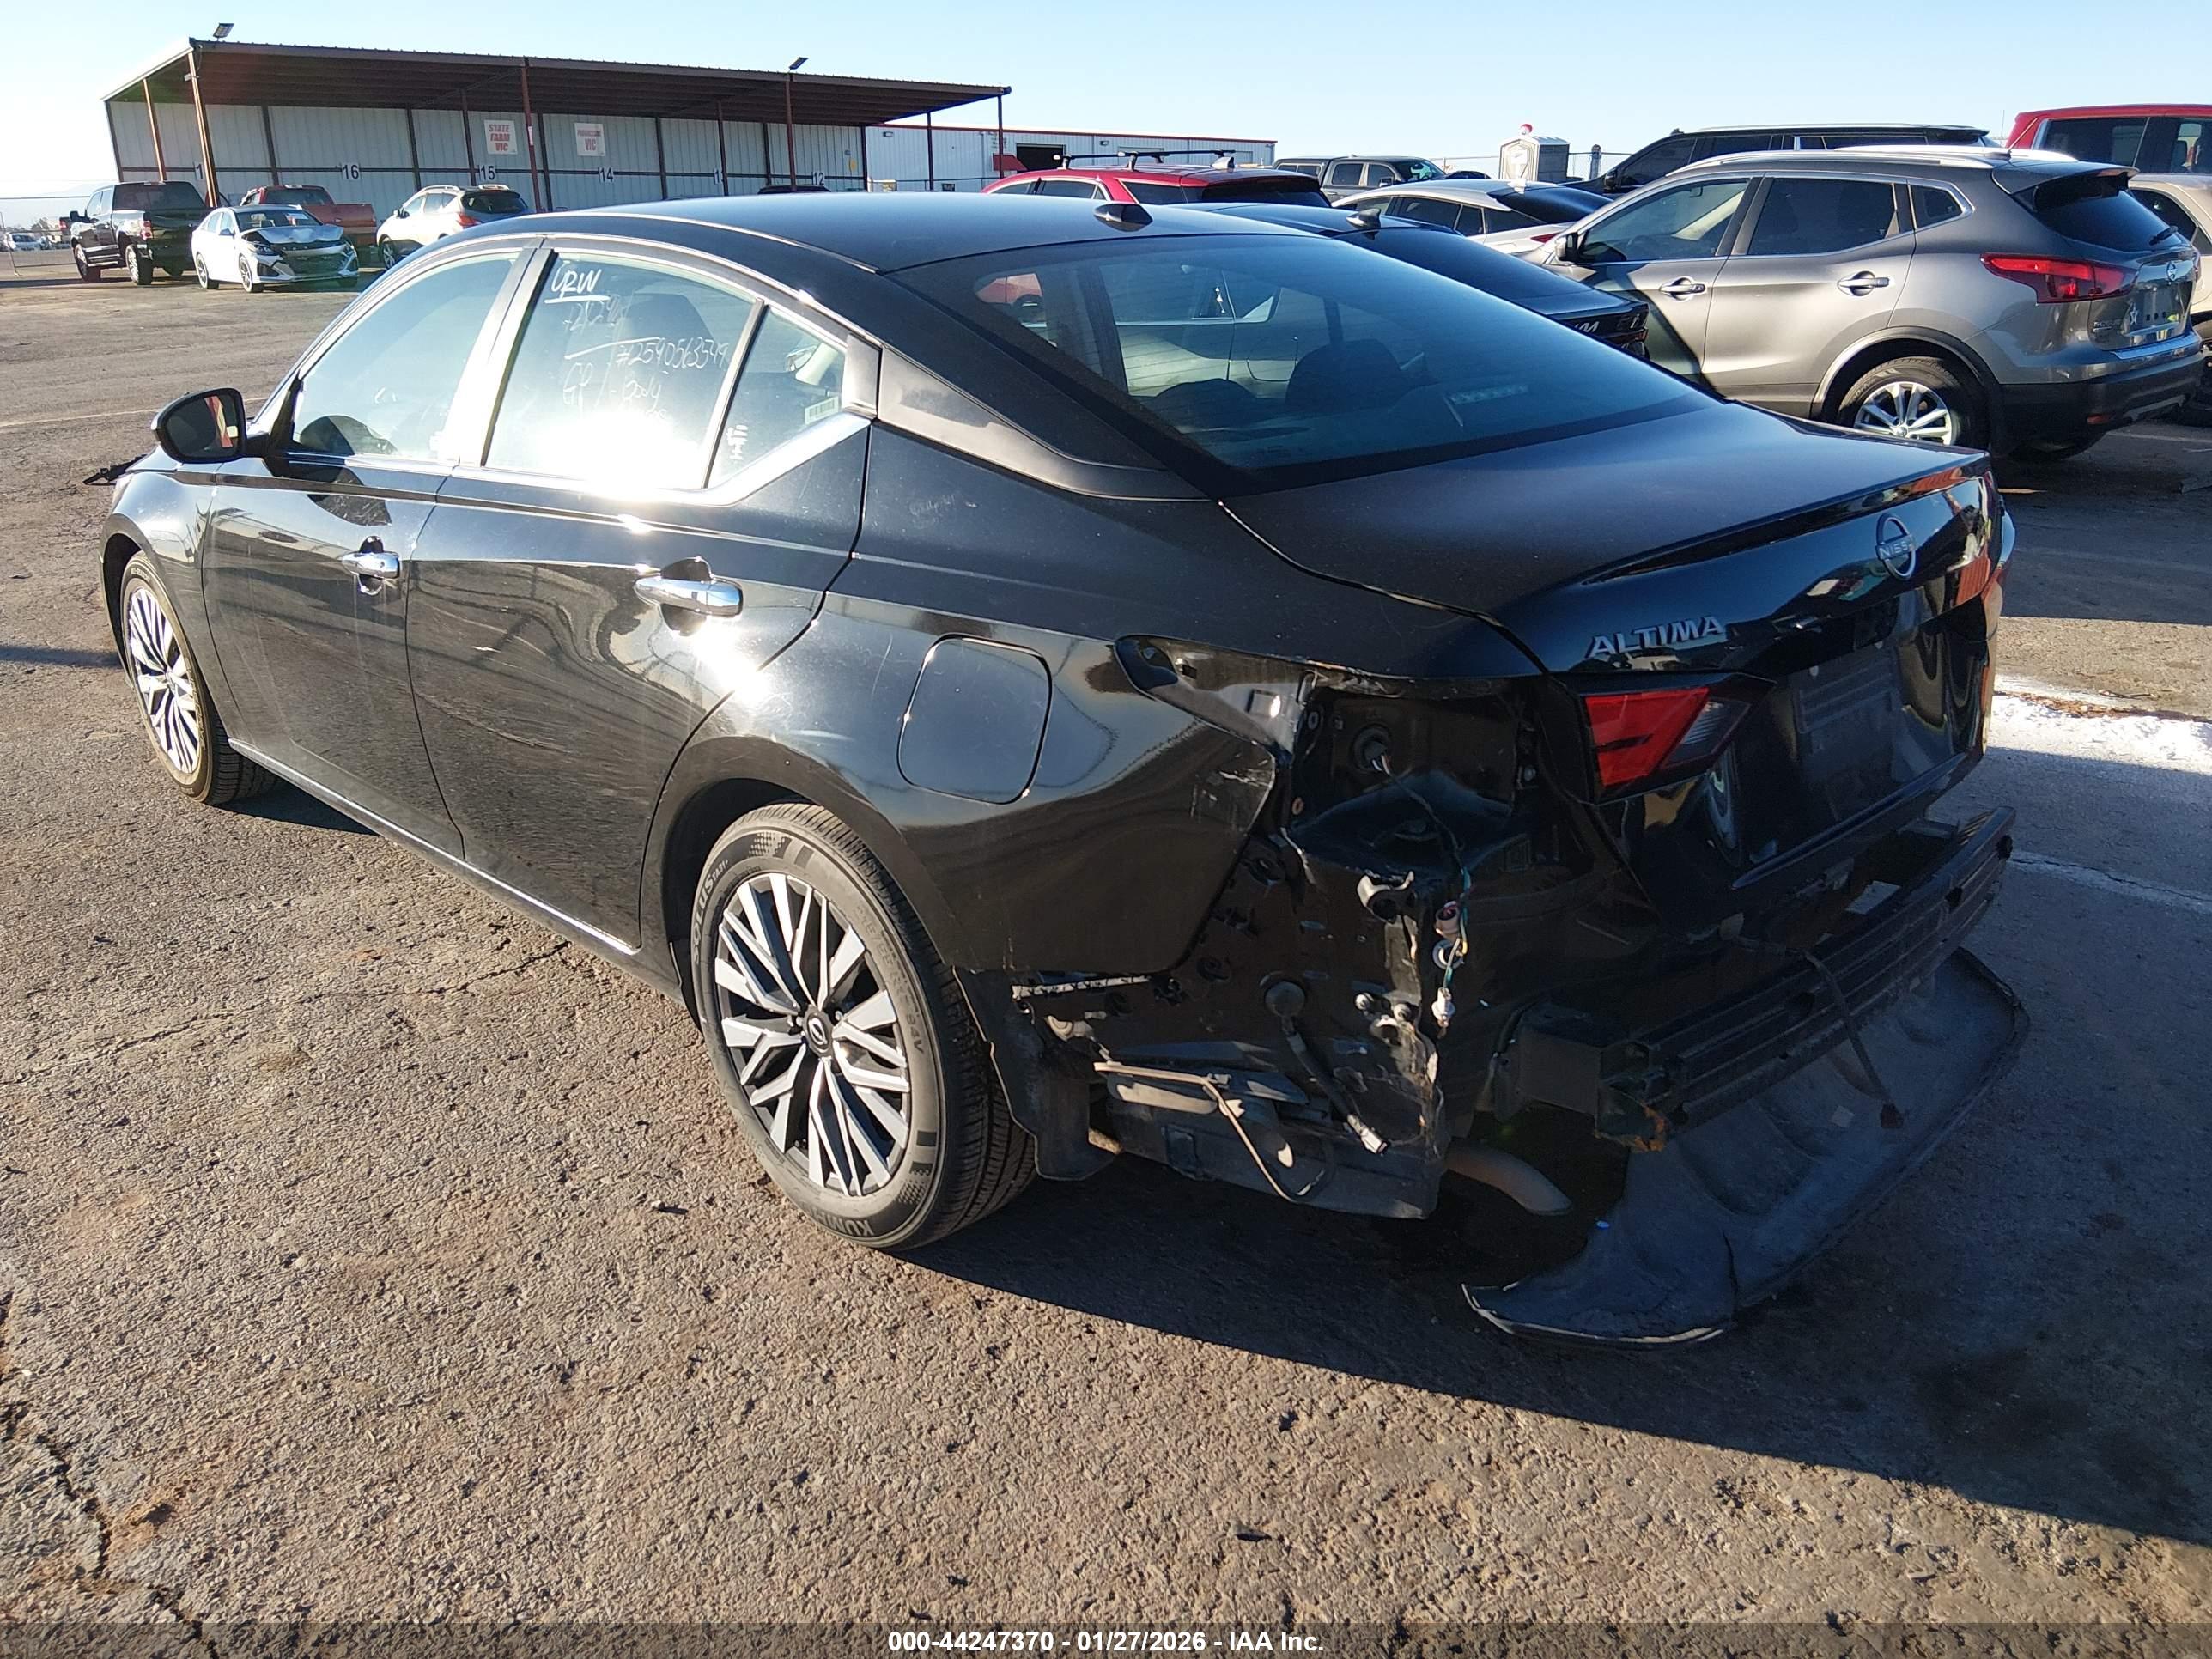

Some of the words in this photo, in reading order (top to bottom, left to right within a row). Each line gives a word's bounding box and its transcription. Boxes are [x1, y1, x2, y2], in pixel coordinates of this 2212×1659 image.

[489, 124, 510, 132] STATE
[490, 133, 510, 142] FARM
[584, 138, 597, 151] VIC
[495, 143, 508, 151] VIC
[343, 164, 360, 179] 16
[481, 166, 495, 180] 15
[599, 167, 614, 182] 14
[814, 171, 825, 185] 12
[1588, 616, 1726, 659] ALTIMA
[693, 874, 715, 966] SOLUS
